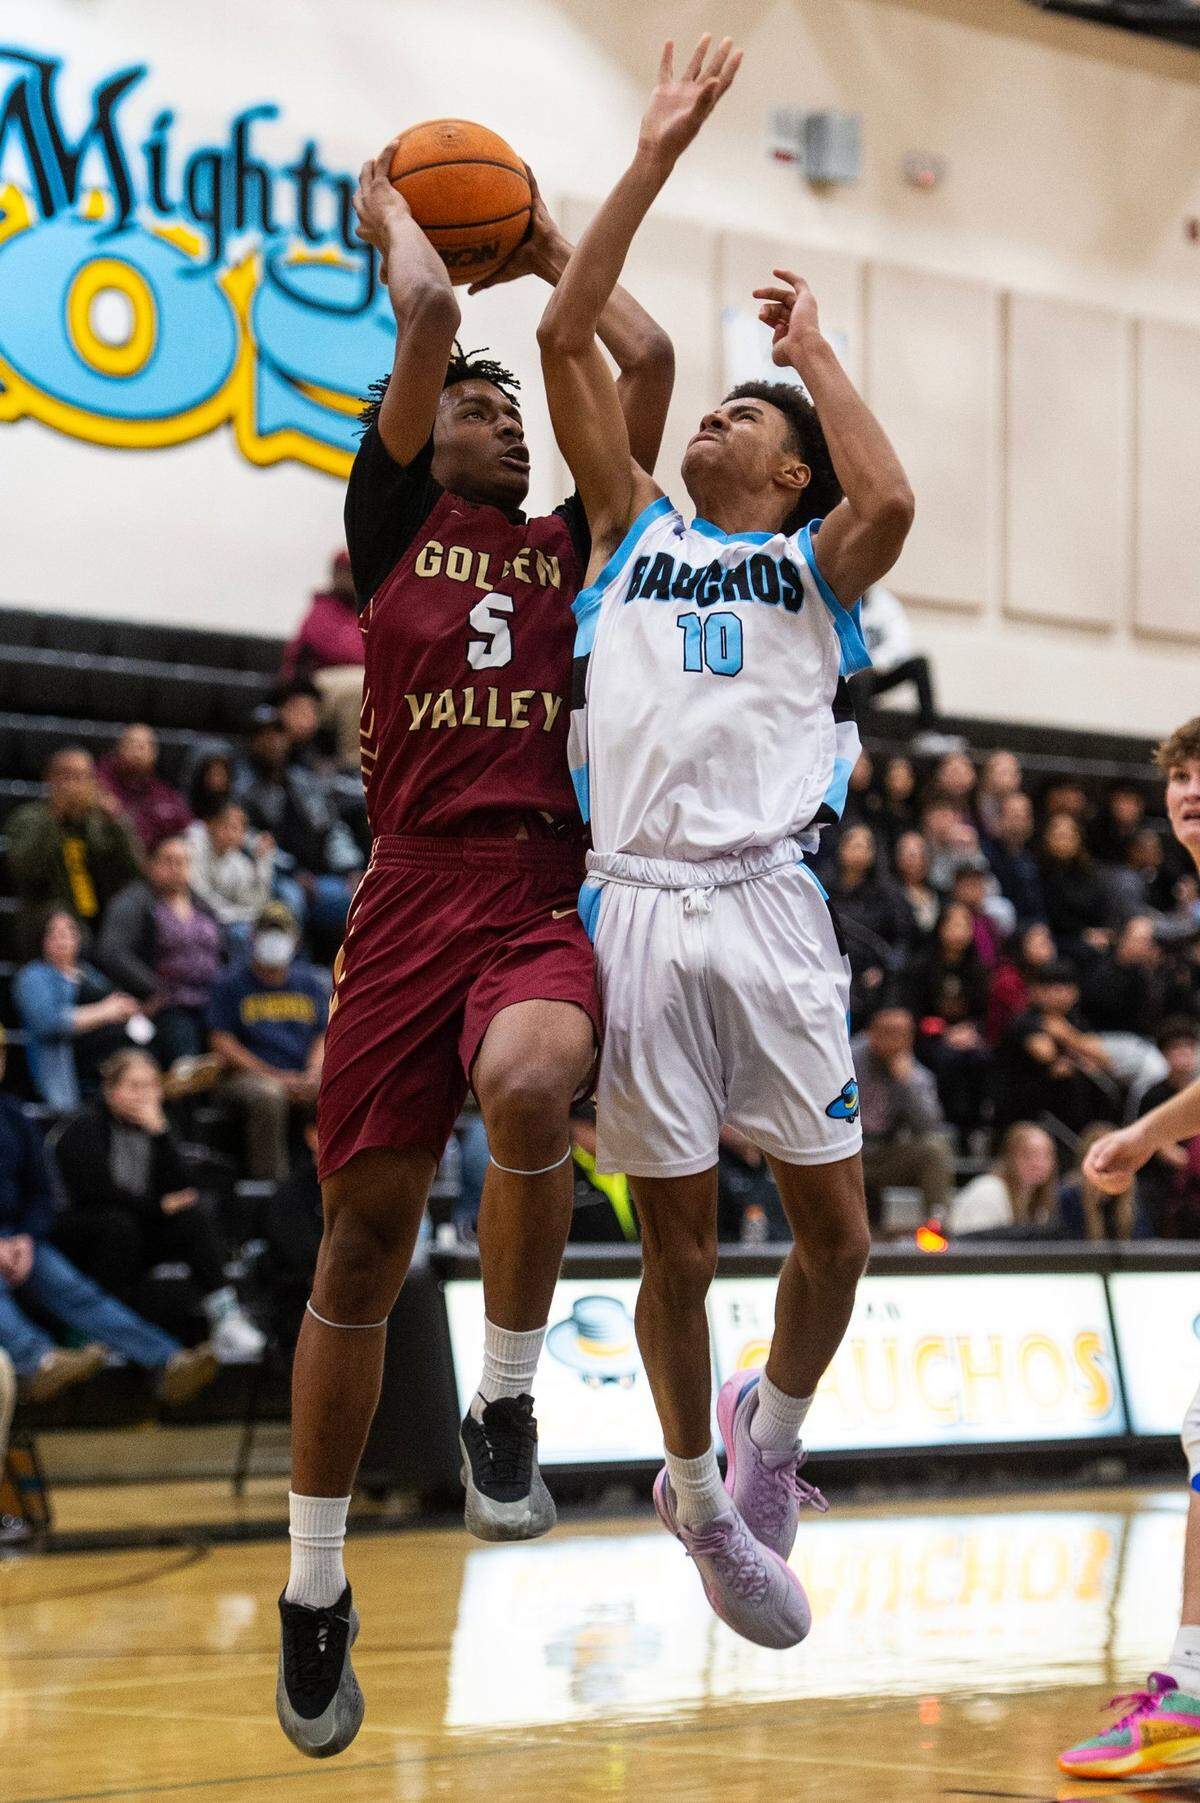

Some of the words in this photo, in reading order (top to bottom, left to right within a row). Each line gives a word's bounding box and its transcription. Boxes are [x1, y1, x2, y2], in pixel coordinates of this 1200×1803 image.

[414, 539, 562, 592] GOLEN
[466, 592, 514, 671] 5
[676, 611, 743, 677] 10
[404, 686, 563, 732] VALLEY
[735, 1330, 1113, 1426] UCHOS
